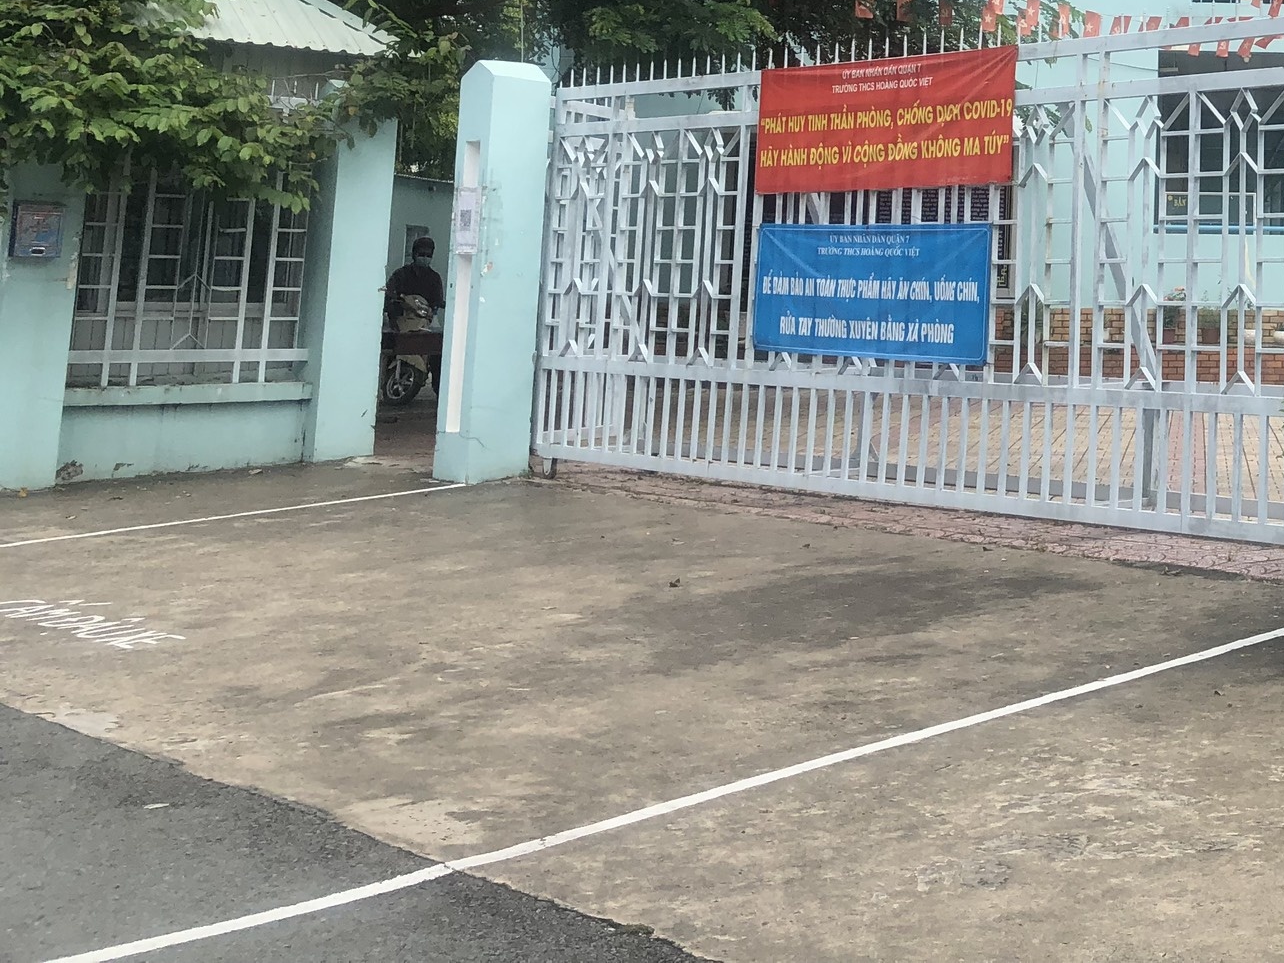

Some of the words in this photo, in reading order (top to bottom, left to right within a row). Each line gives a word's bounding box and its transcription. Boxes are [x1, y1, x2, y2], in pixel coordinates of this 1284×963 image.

[859, 82, 875, 92] THCS
[875, 79, 899, 91] HOÀNG
[788, 115, 806, 133] HUY
[807, 113, 828, 132] TINH
[830, 103, 855, 130] THẦN
[856, 105, 894, 130] PHÒNG,
[896, 99, 934, 126] CHỐNG
[936, 103, 961, 127] DỊCH
[963, 98, 1013, 120] COVID-19
[760, 145, 779, 168] HÃY
[780, 143, 807, 167] HÀNH
[809, 141, 840, 170] ĐỘNG
[842, 140, 852, 164] VÌ
[853, 139, 885, 168] CỘNG
[888, 133, 918, 161] ĐỒNG
[921, 133, 961, 159] KHÔNG
[963, 136, 981, 156] MA
[843, 247, 860, 256] THCS
[804, 277, 815, 296] AN
[816, 274, 837, 297] TOÀN
[837, 277, 857, 303] THỰC
[857, 272, 880, 299] PHẨM
[780, 310, 796, 335] RỬA
[798, 317, 813, 336] TAY
[814, 314, 848, 338] THƯỜNG
[849, 317, 879, 341] XUYÊN
[880, 313, 905, 341] BẰNG
[921, 318, 955, 344] PHÒNG
[92, 629, 187, 649] XE
